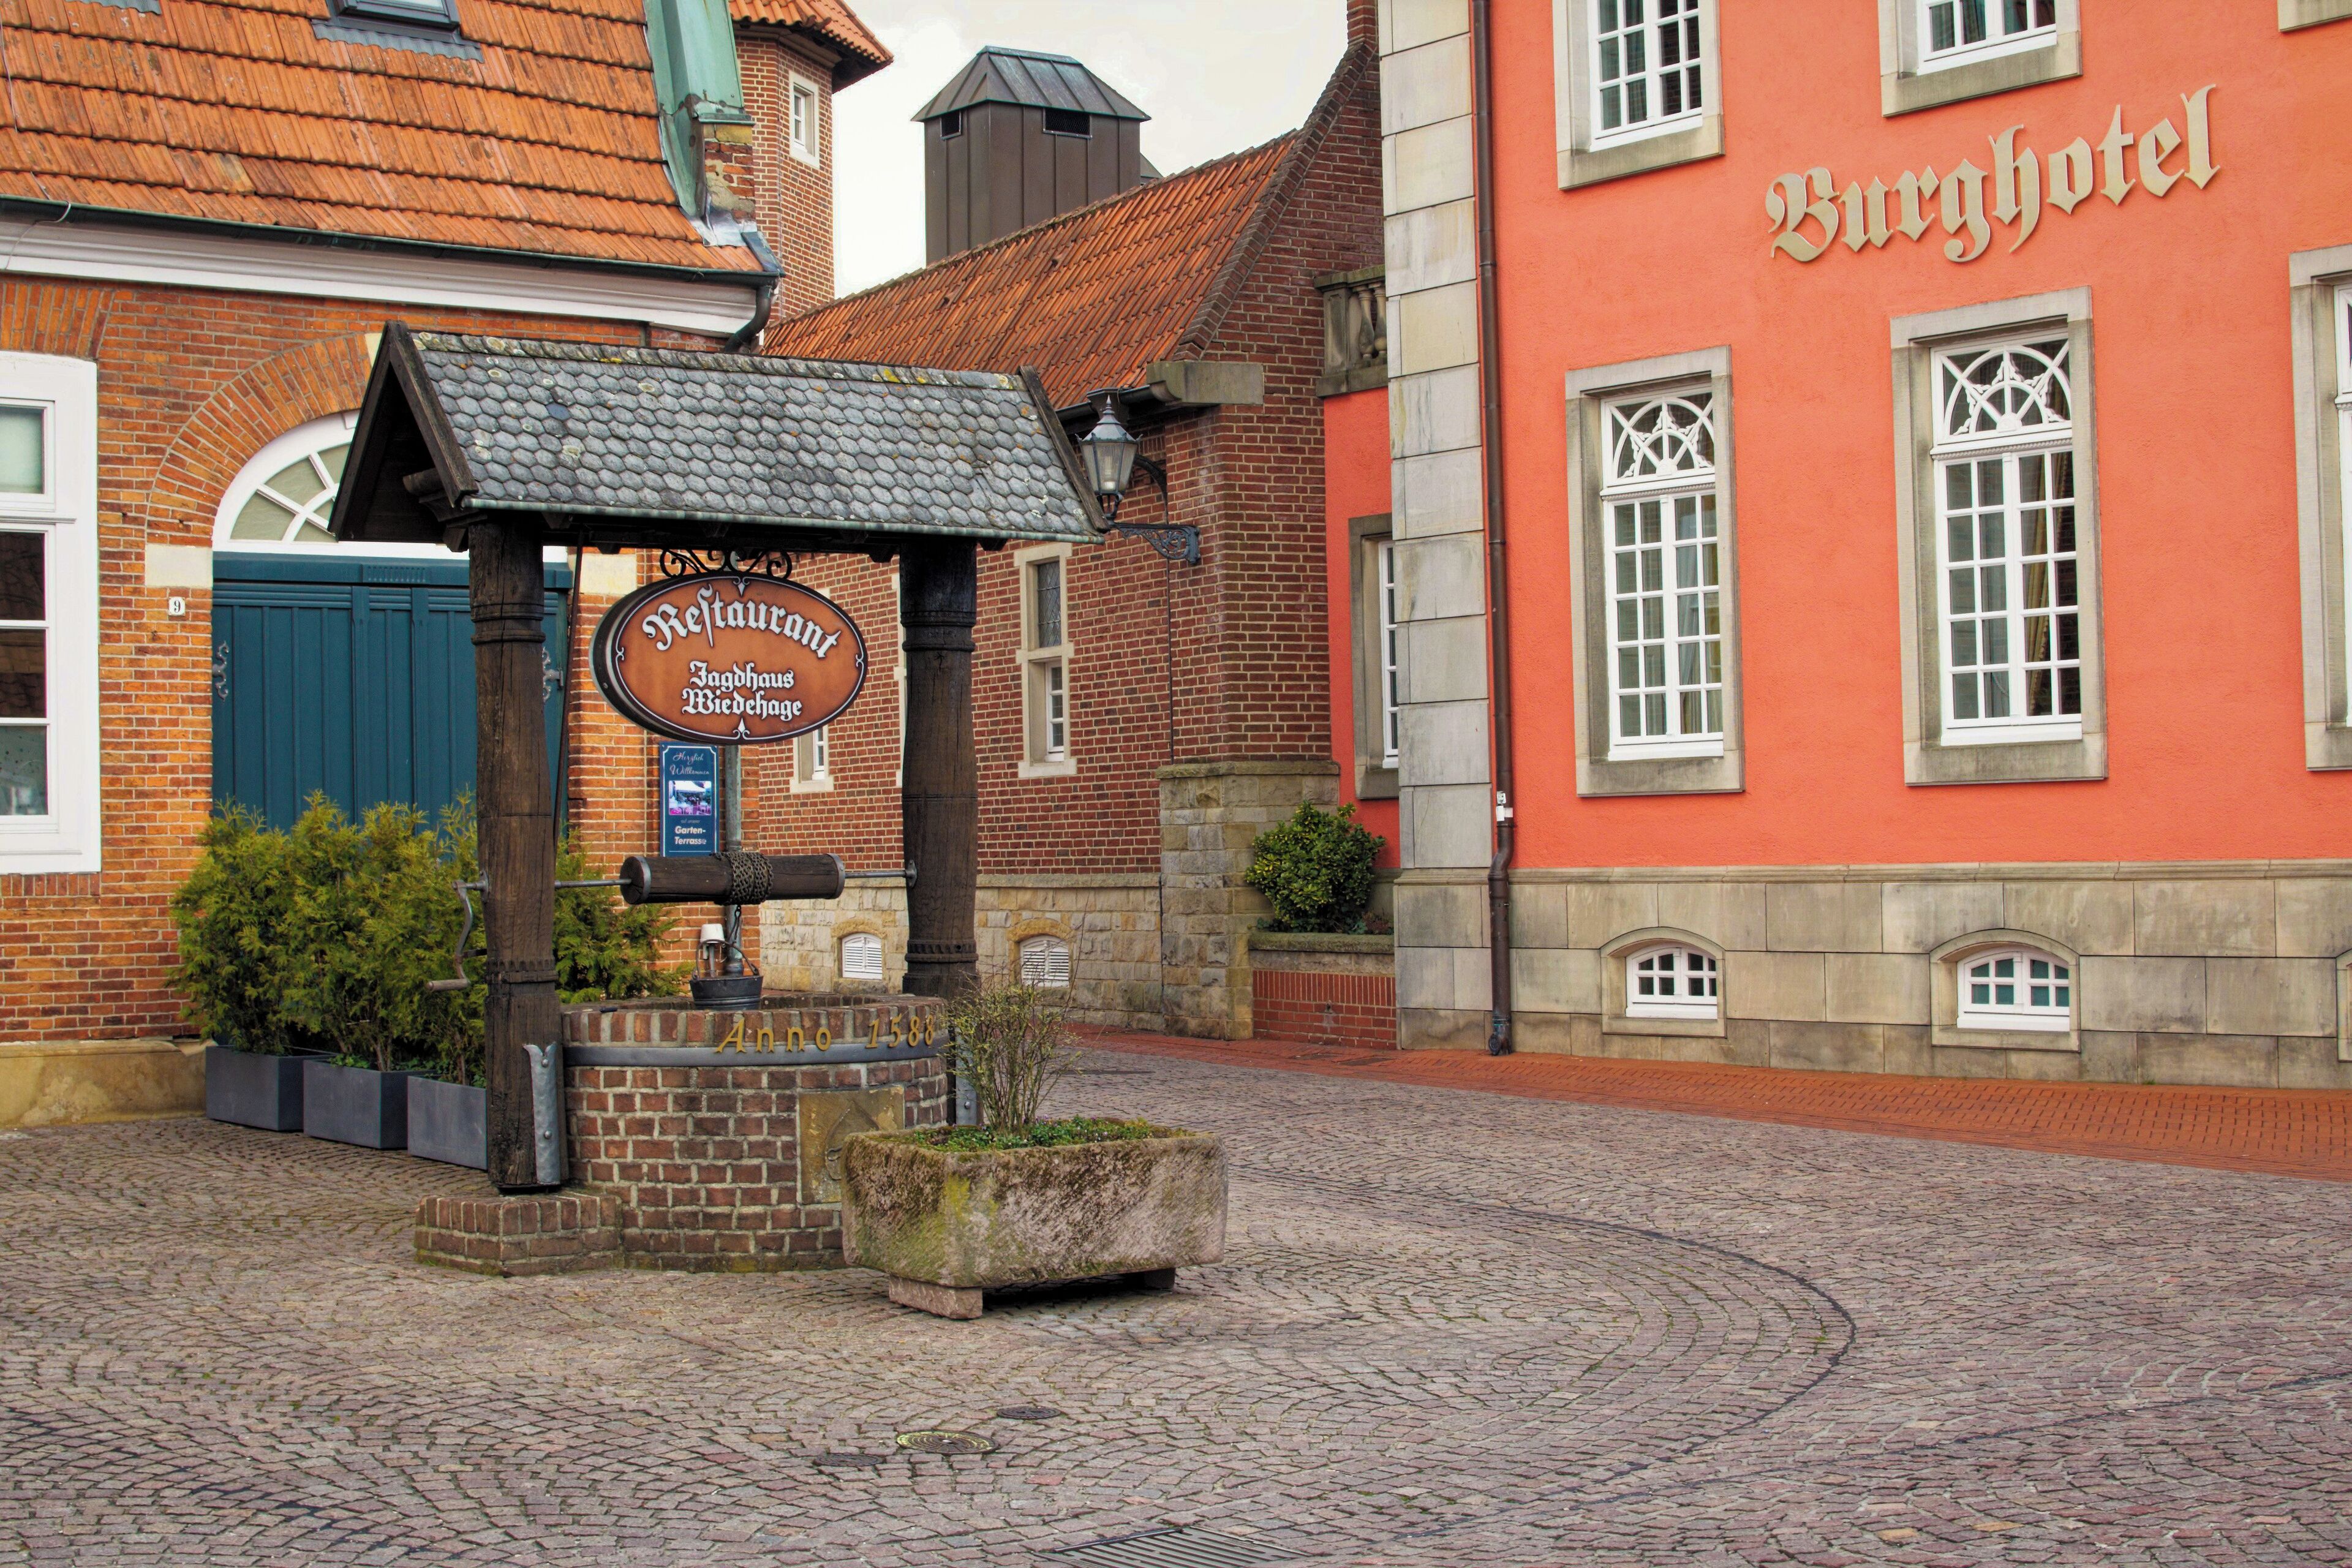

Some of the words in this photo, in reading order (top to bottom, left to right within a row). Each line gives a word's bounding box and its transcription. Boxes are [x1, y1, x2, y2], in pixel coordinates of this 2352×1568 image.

[1765, 83, 2221, 263] Burghotel
[174, 600, 181, 613] 9
[689, 661, 794, 690] Jagdhaus
[681, 688, 803, 721] Wiedehage
[715, 1017, 832, 1054] Anno
[865, 1014, 936, 1049] 1588
